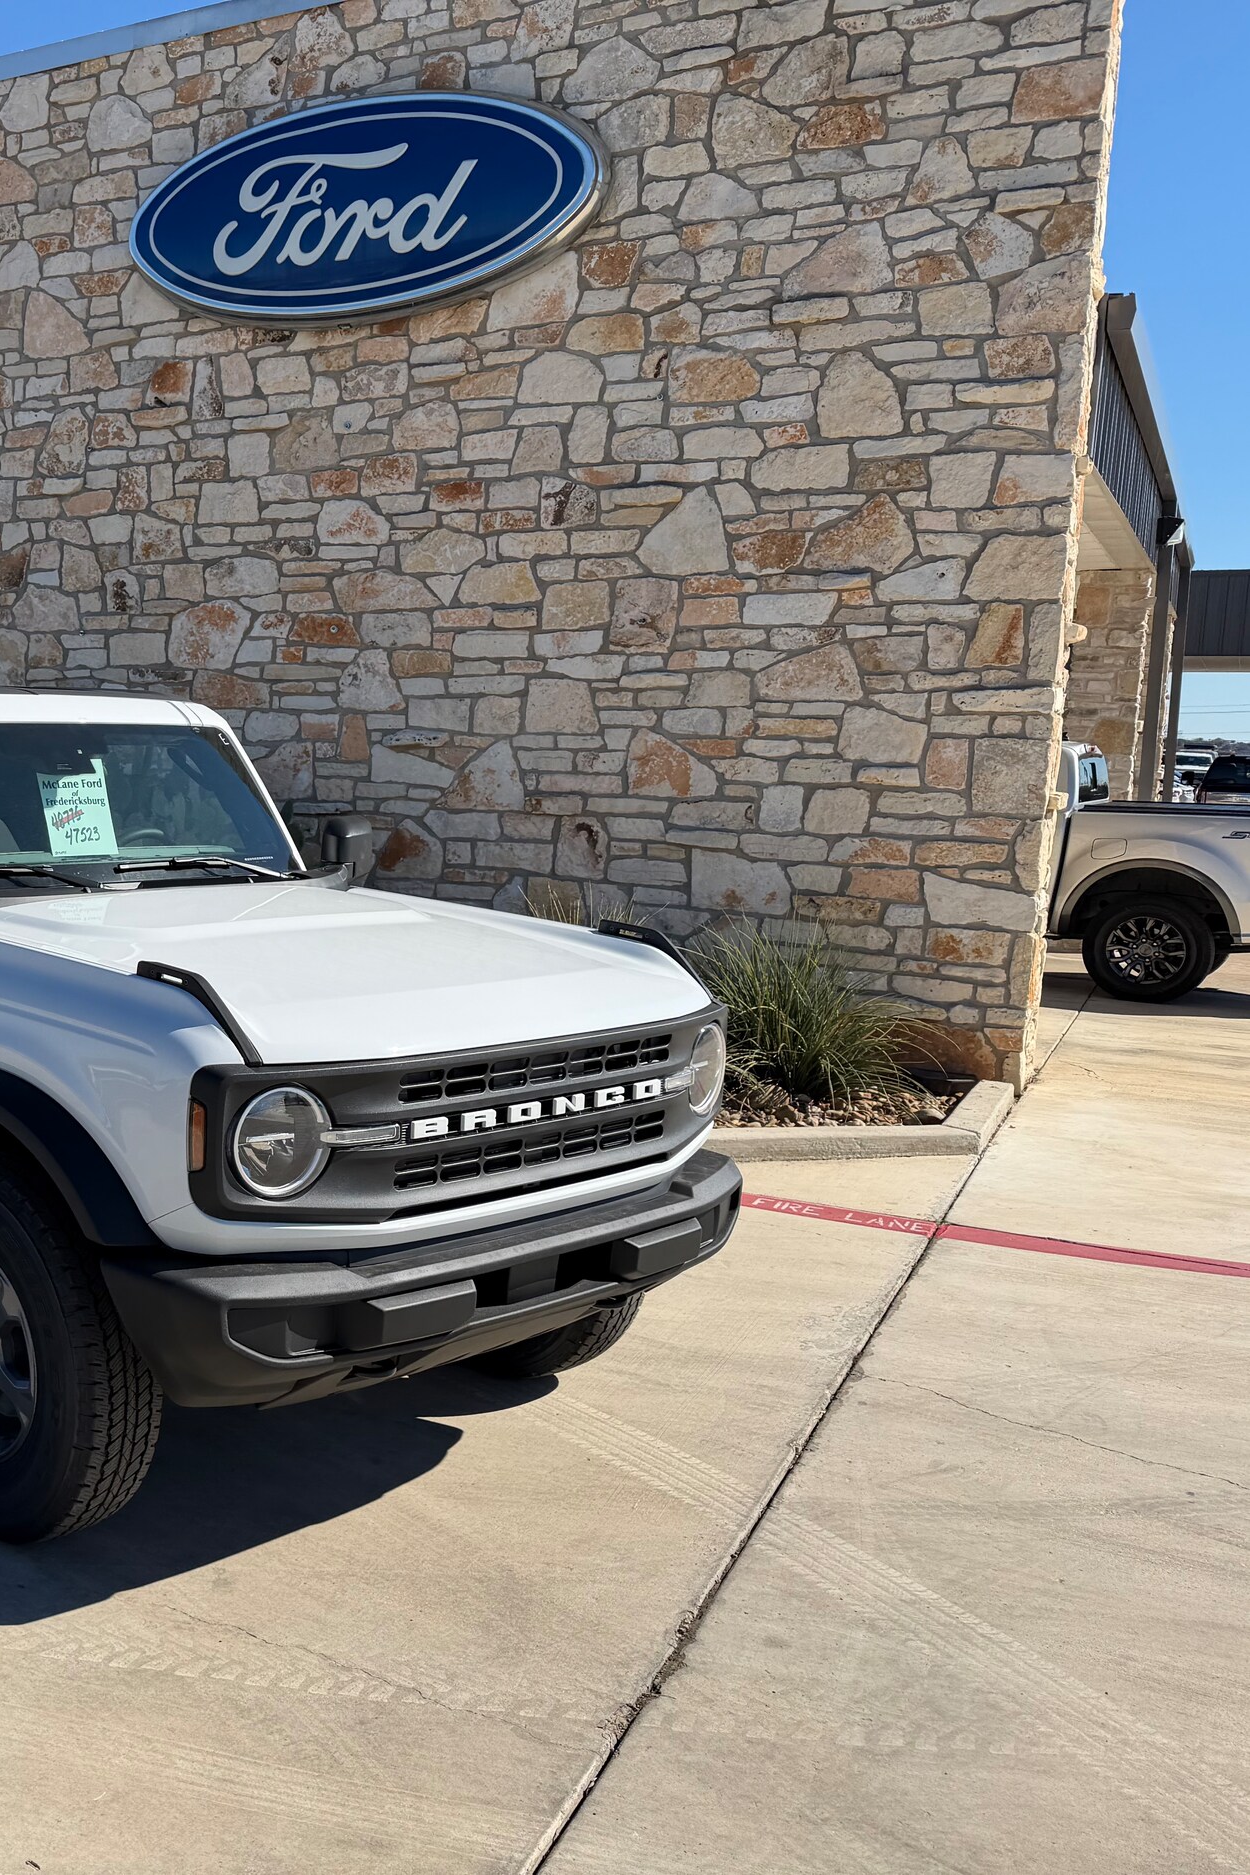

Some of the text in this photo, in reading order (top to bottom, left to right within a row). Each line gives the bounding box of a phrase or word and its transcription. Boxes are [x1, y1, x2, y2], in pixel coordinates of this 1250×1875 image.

[212, 142, 479, 276] Ford
[42, 778, 103, 790] McLane Ford
[71, 789, 79, 797] of
[46, 797, 106, 807] Fredericksburg
[65, 826, 101, 845] 47523
[410, 1079, 662, 1140] BRONCO
[752, 1197, 934, 1233] FIRE LANE
